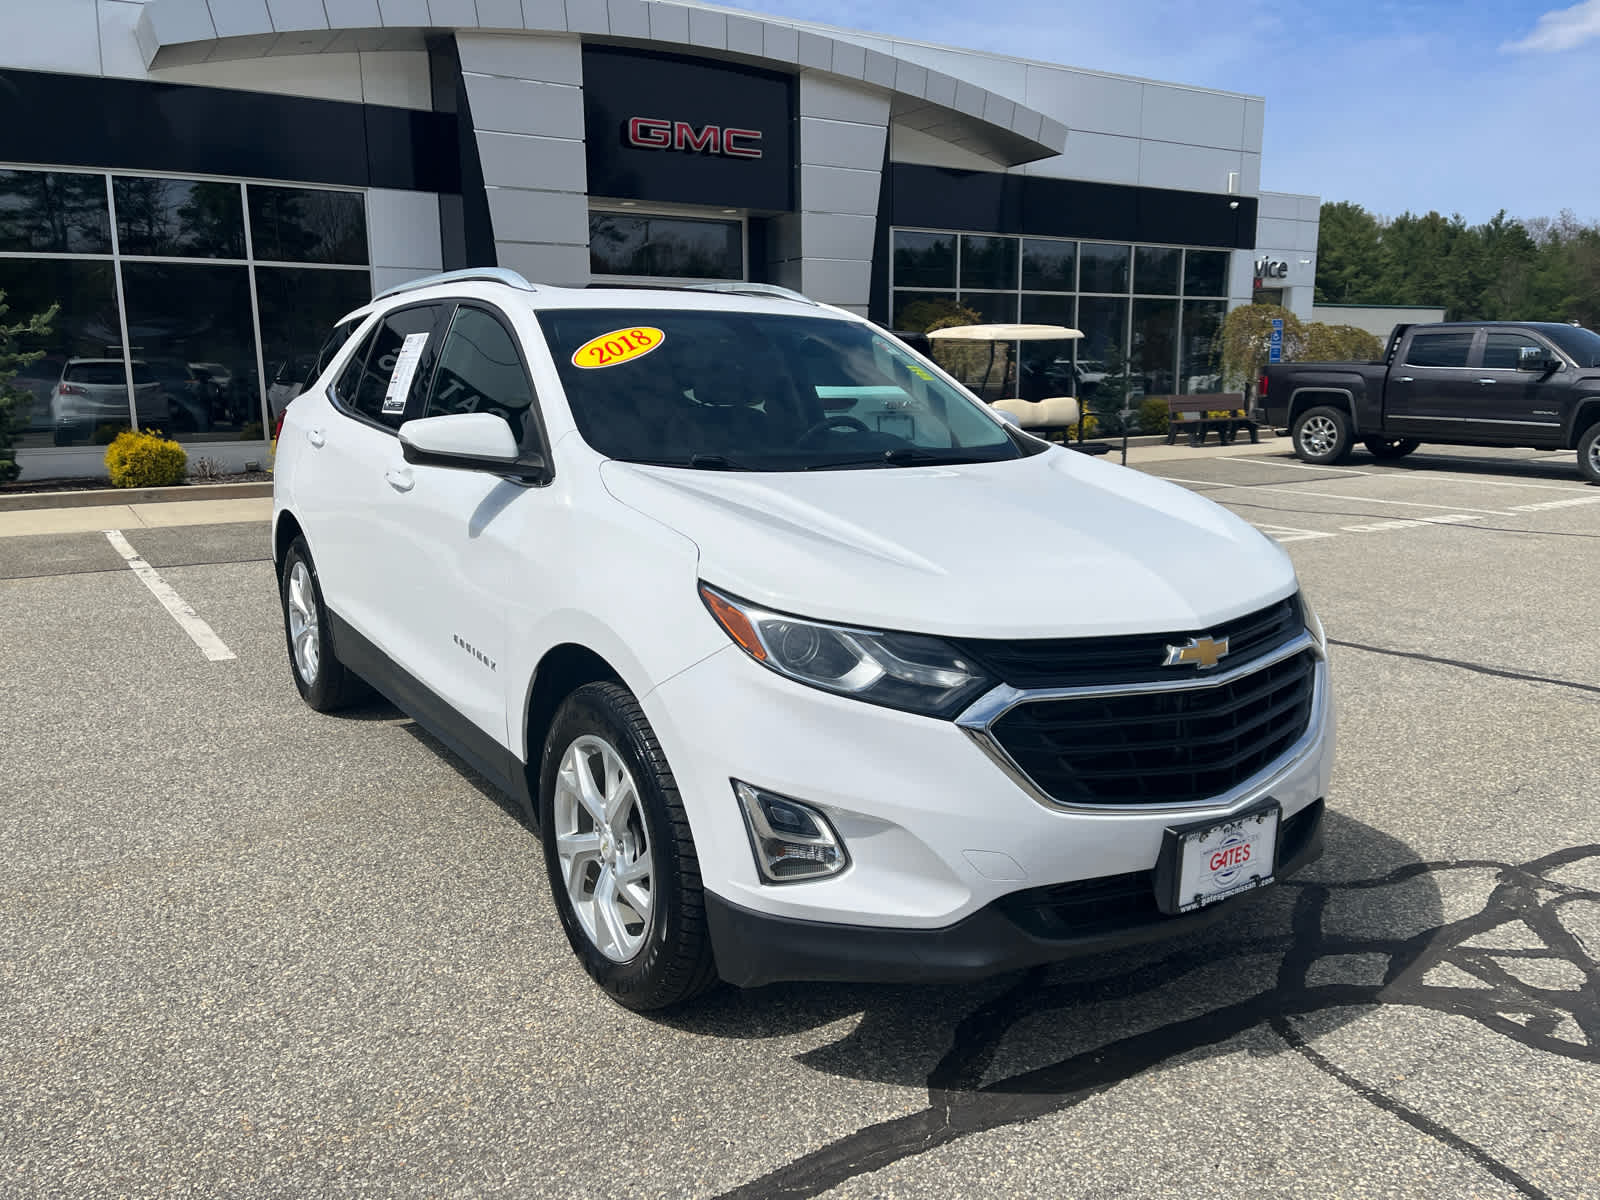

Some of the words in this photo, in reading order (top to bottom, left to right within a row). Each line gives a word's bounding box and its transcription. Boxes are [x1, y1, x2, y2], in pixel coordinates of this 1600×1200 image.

[628, 116, 763, 159] GMC
[590, 330, 653, 365] 2018
[1209, 843, 1251, 871] GATES
